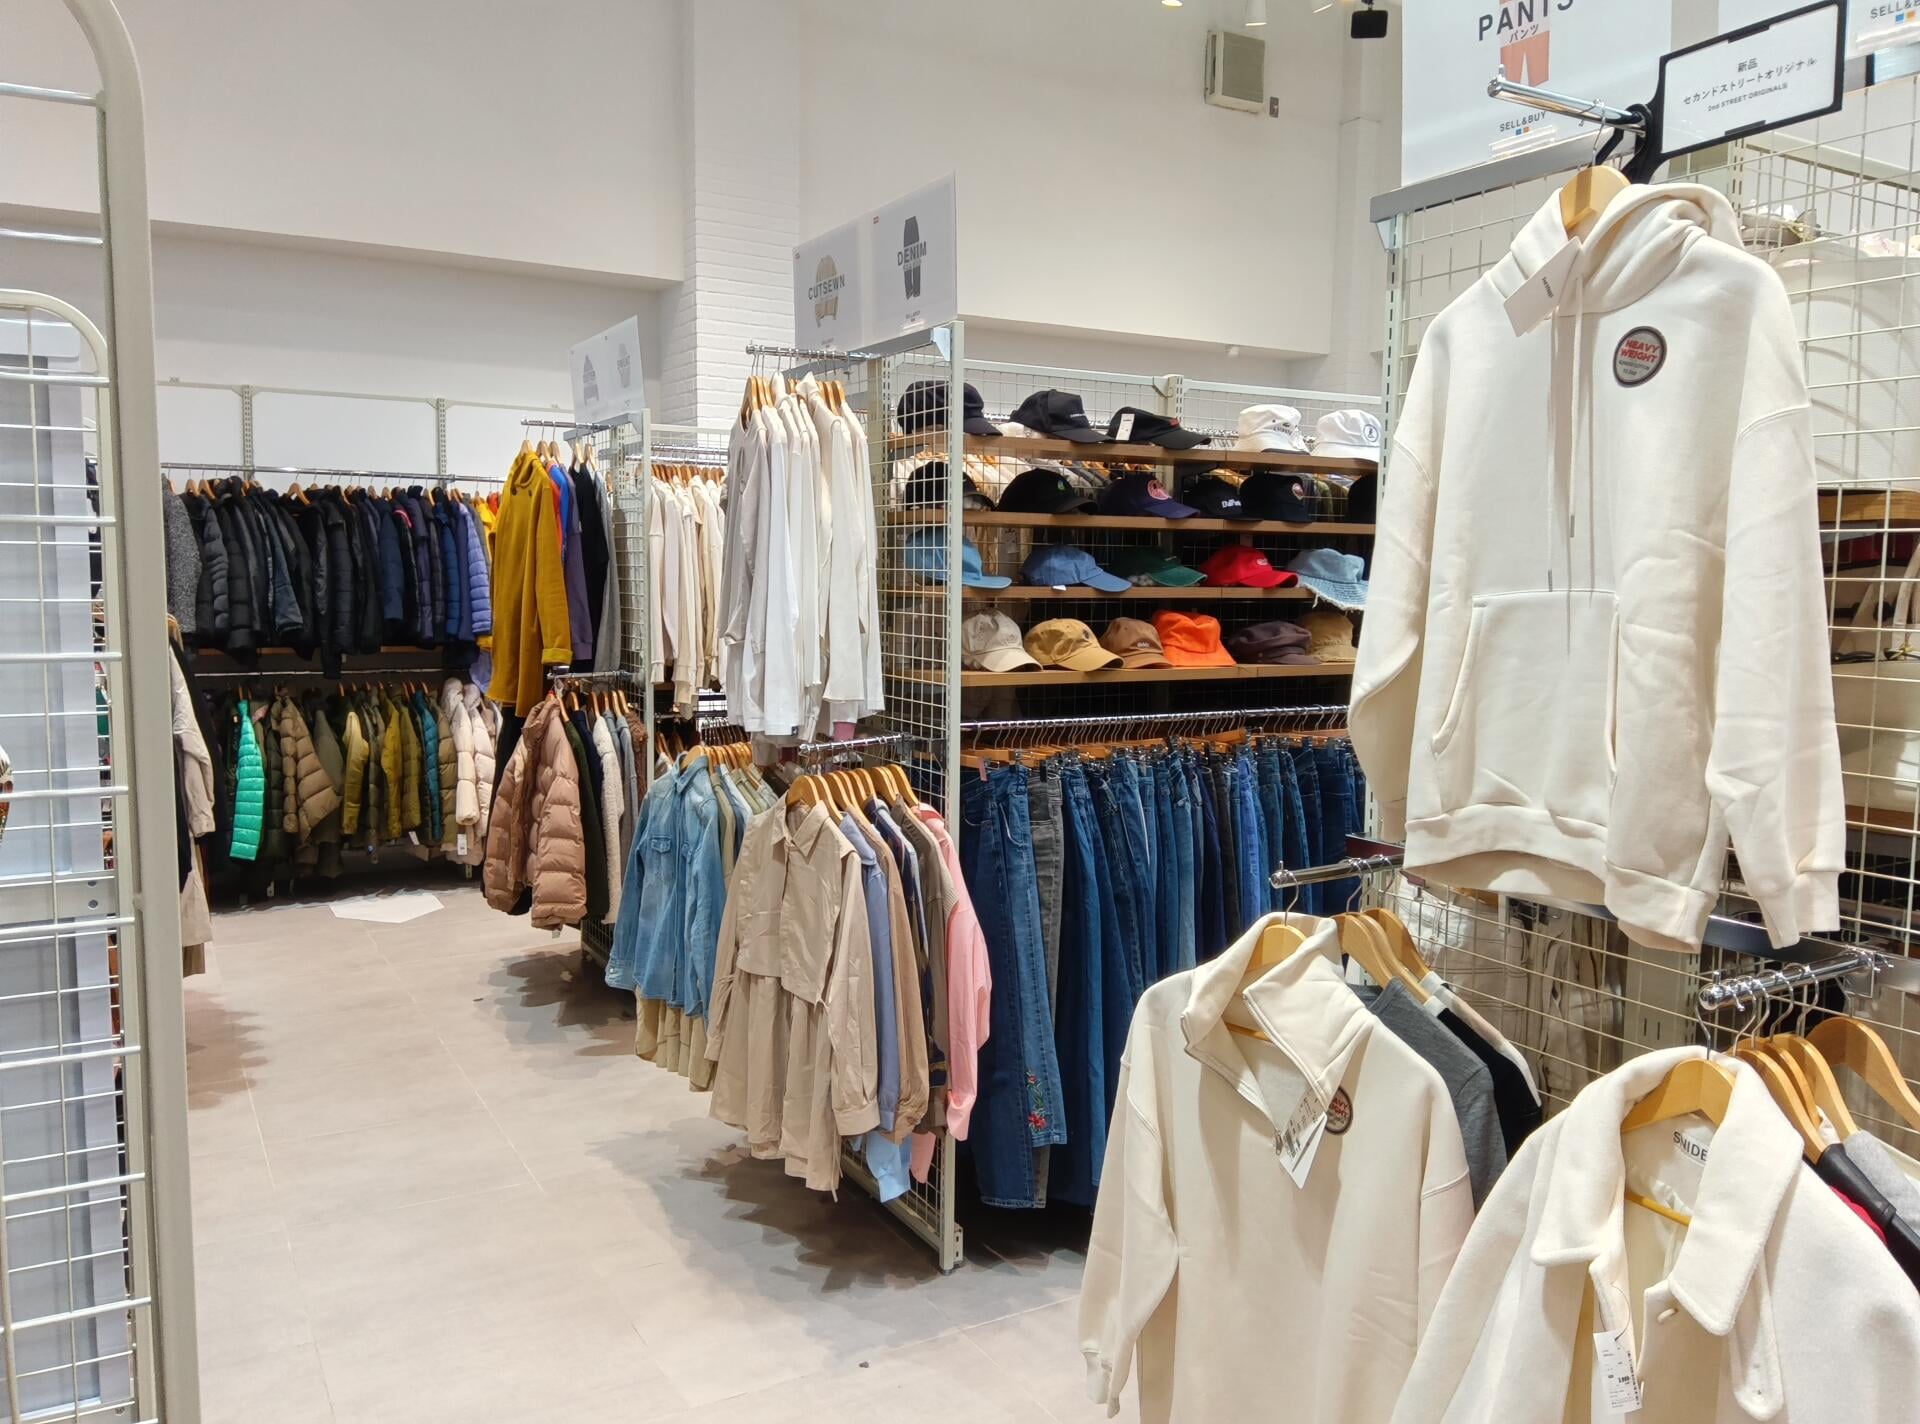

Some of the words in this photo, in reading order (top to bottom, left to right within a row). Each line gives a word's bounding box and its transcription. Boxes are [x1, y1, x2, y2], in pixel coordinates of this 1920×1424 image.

[1509, 23, 1539, 43] パンツ
[1737, 58, 1758, 73] 新品
[1683, 57, 1817, 105] セカンドストリートオリジナル
[1708, 103, 1720, 112] 2nd
[1721, 94, 1747, 108] STREET
[1748, 82, 1788, 99] ORIGINALS
[1500, 111, 1546, 132] SELL&BUY
[897, 241, 927, 267] DENIM
[808, 274, 846, 300] CUTSEWN
[1621, 348, 1658, 363] WEIGHT
[1625, 339, 1660, 353] HEAVY
